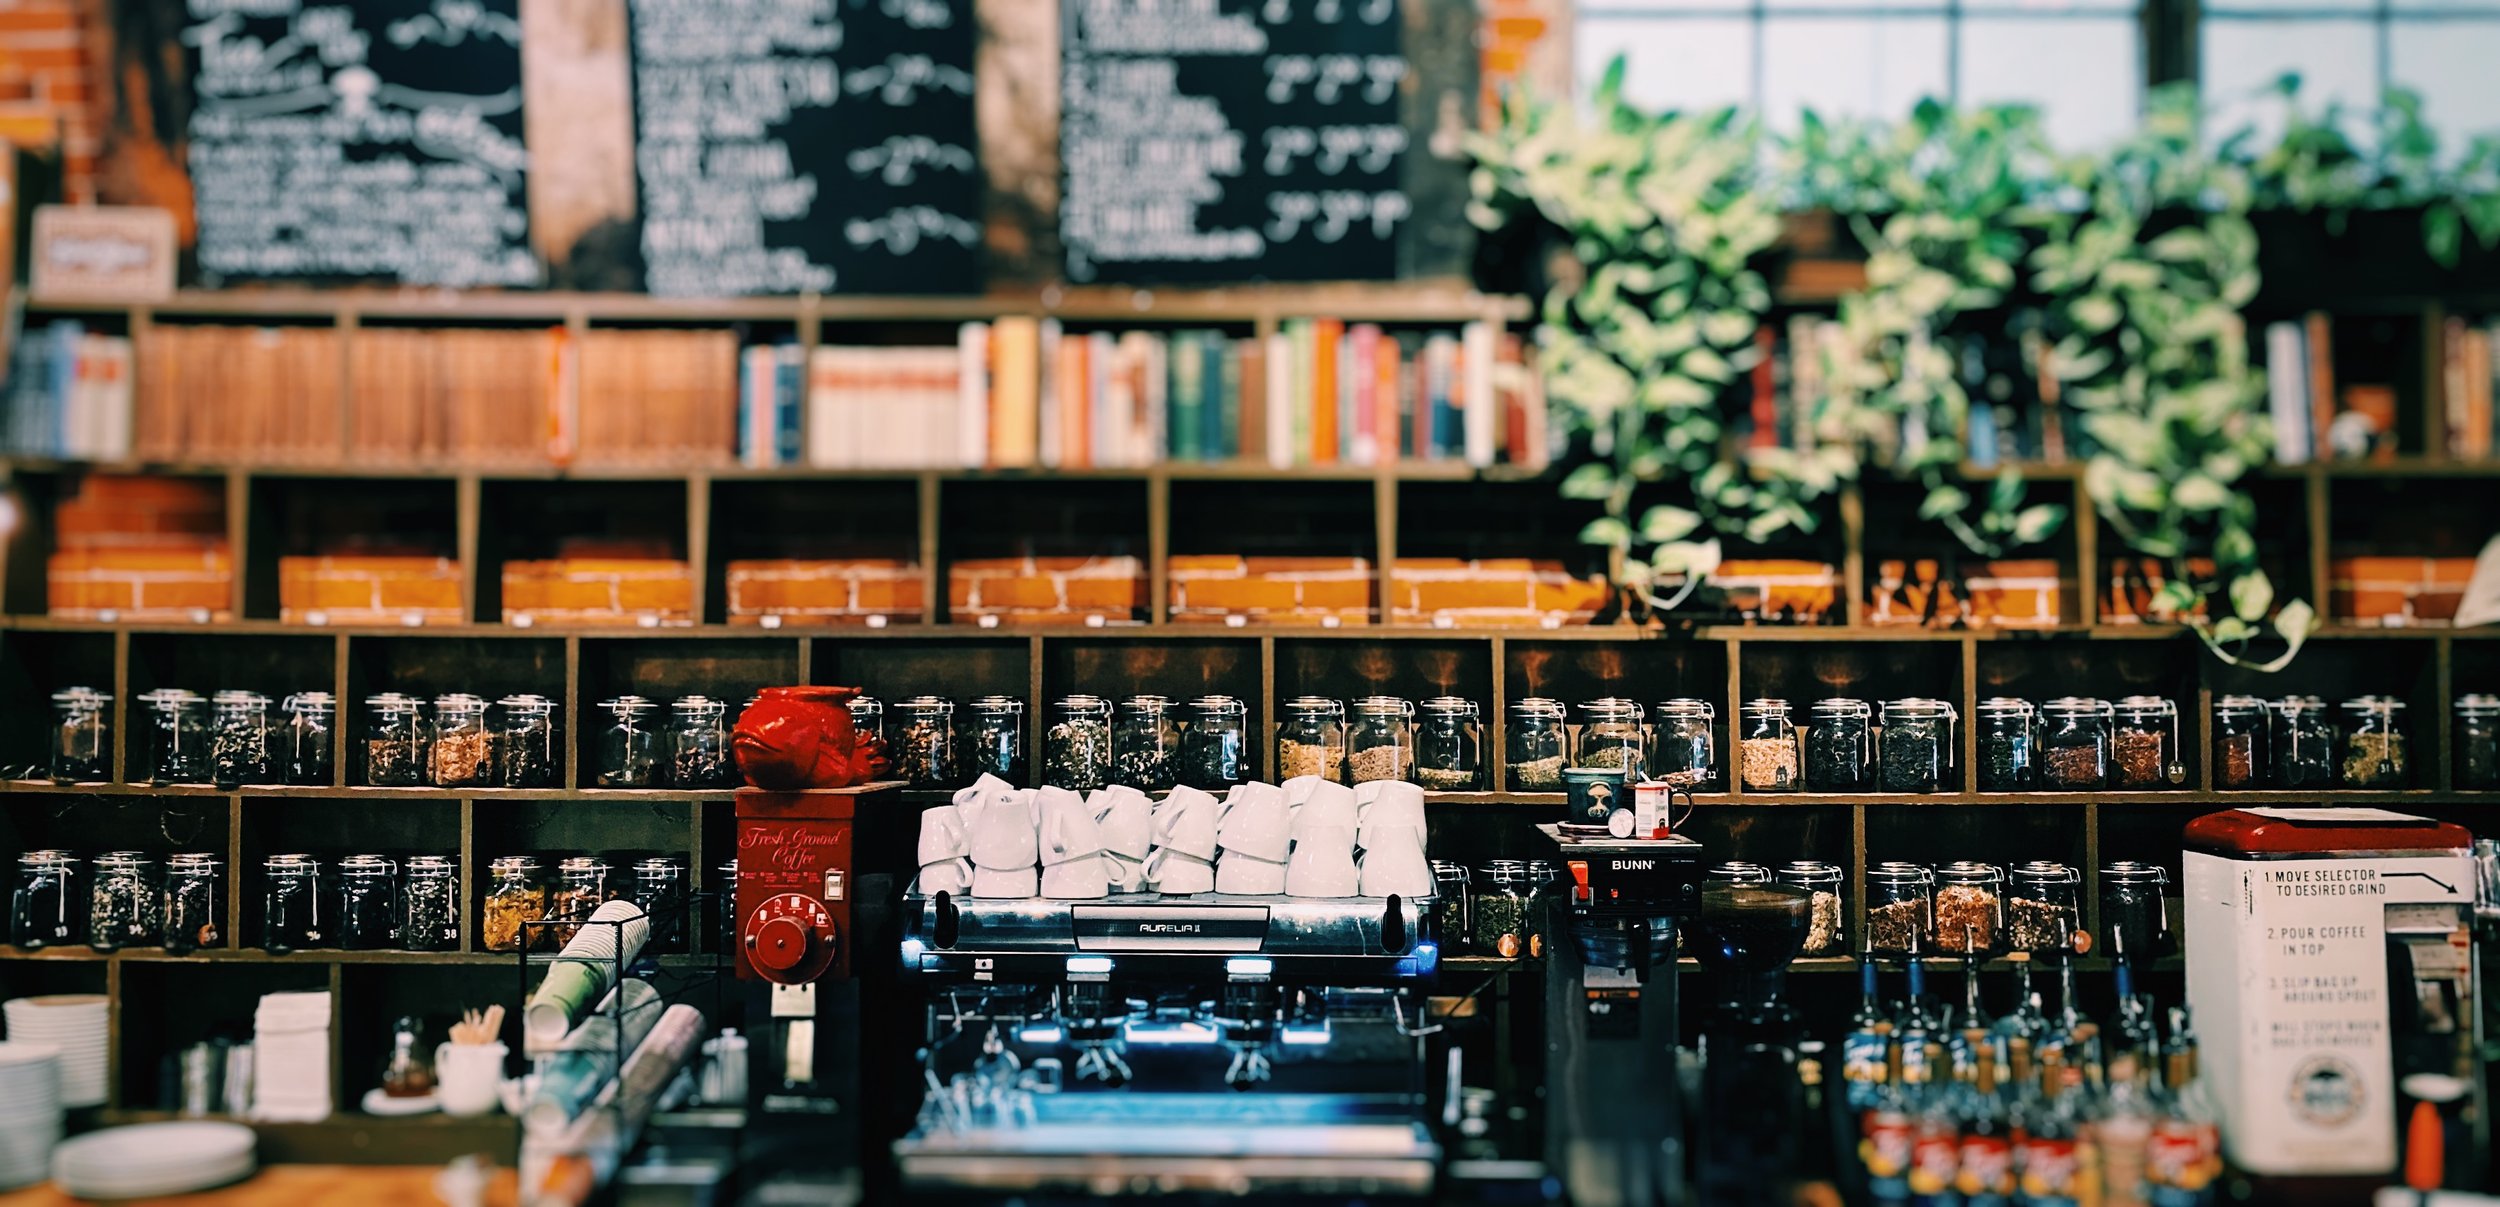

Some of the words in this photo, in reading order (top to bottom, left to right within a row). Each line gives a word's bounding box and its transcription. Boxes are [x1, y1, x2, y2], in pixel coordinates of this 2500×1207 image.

[259, 762, 267, 774] 3
[478, 768, 486, 778] 6
[410, 770, 418, 780] 5
[625, 770, 633, 782] 8
[739, 827, 788, 849] Fresh
[787, 826, 846, 849] Ground
[772, 846, 816, 871] Coffee
[1611, 860, 1653, 870] BUNN
[2275, 870, 2310, 883] MOVE
[2315, 869, 2376, 882] SELECTOR
[2276, 885, 2292, 897] TO
[2295, 884, 2346, 896] DESIRED
[2349, 883, 2386, 895] GRIND
[443, 928, 457, 940] 38
[1139, 924, 1193, 933] AURELIA
[2281, 927, 2315, 940] POUR
[2319, 926, 2366, 939] COFFEE
[2282, 944, 2297, 956] IN
[2301, 943, 2326, 956] TOP
